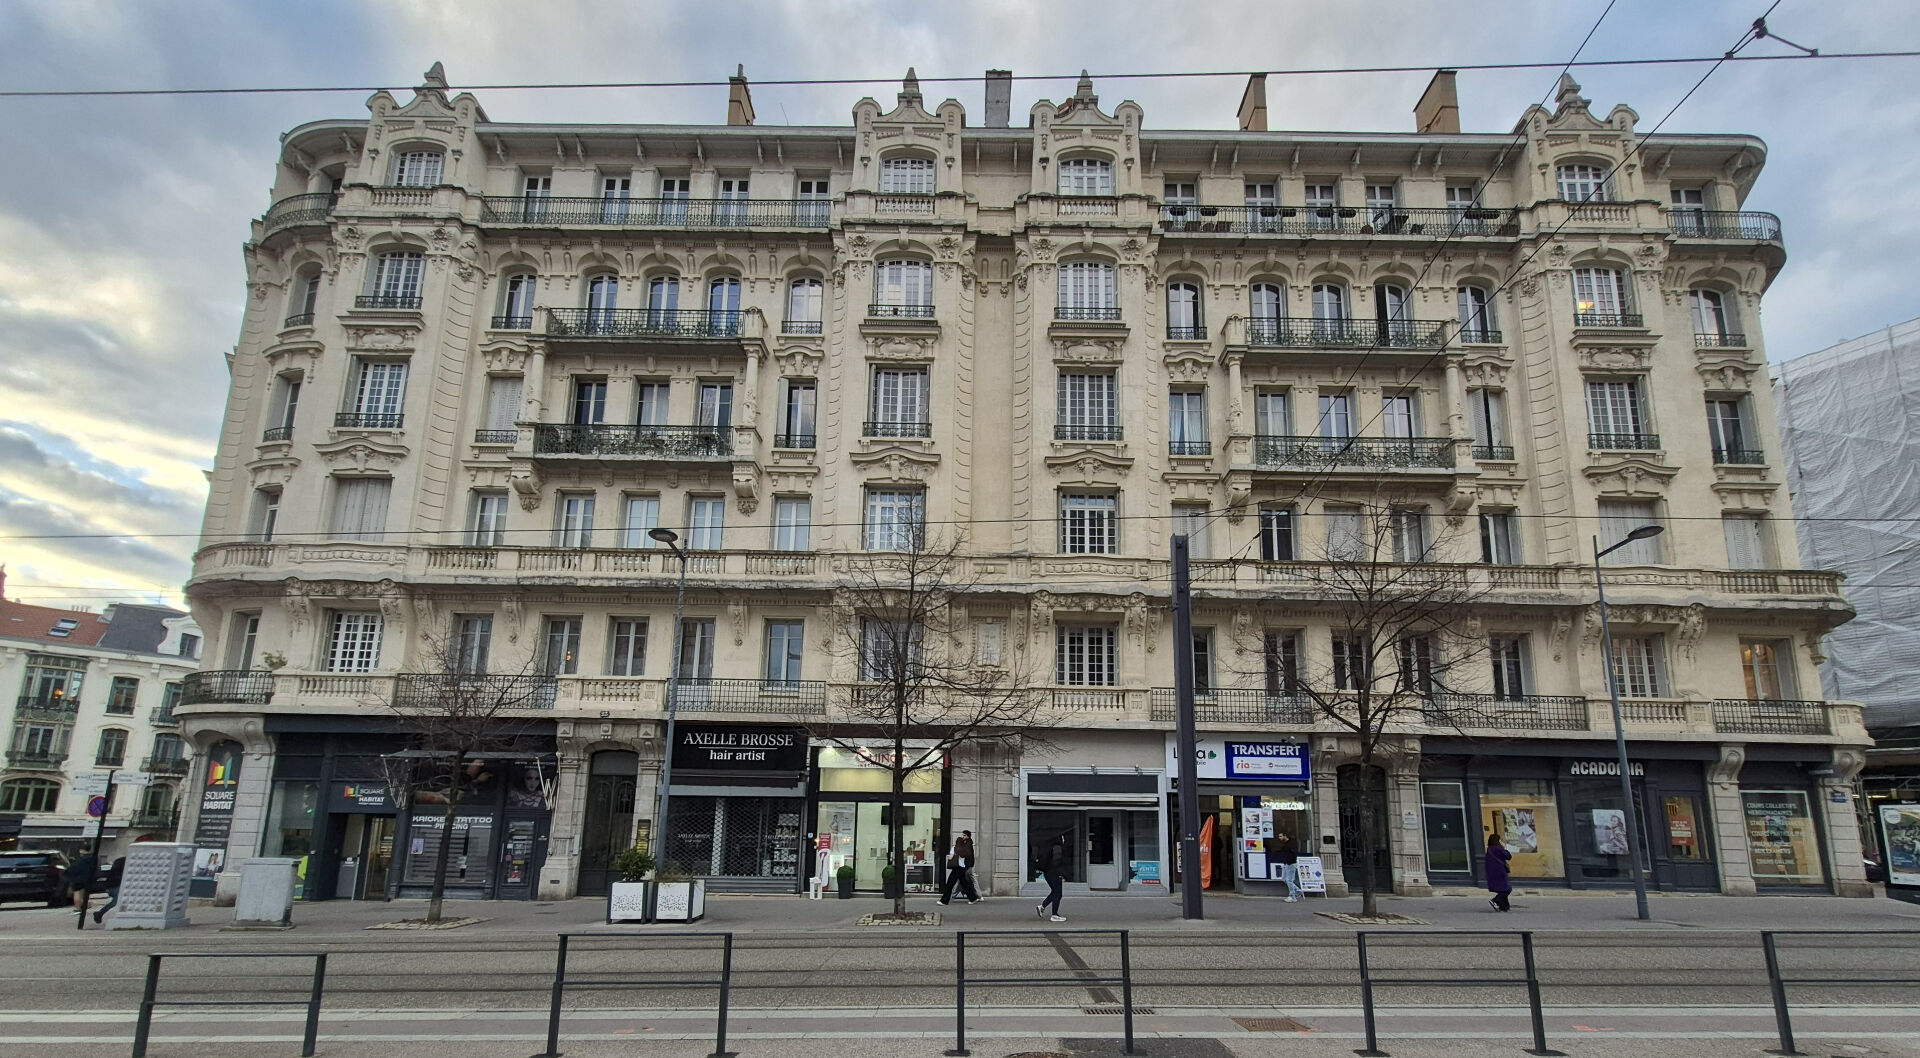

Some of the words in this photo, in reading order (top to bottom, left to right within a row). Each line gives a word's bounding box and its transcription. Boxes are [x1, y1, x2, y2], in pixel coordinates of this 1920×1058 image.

[684, 732, 737, 745] AXELLE
[741, 734, 794, 746] BROSSE
[710, 750, 733, 760] hair
[736, 751, 765, 761] artist
[1173, 747, 1206, 759] La
[1232, 744, 1301, 756] TRANSFERT
[1236, 760, 1250, 769] ria
[205, 791, 235, 800] SQUARE
[203, 801, 233, 810] HABITAT
